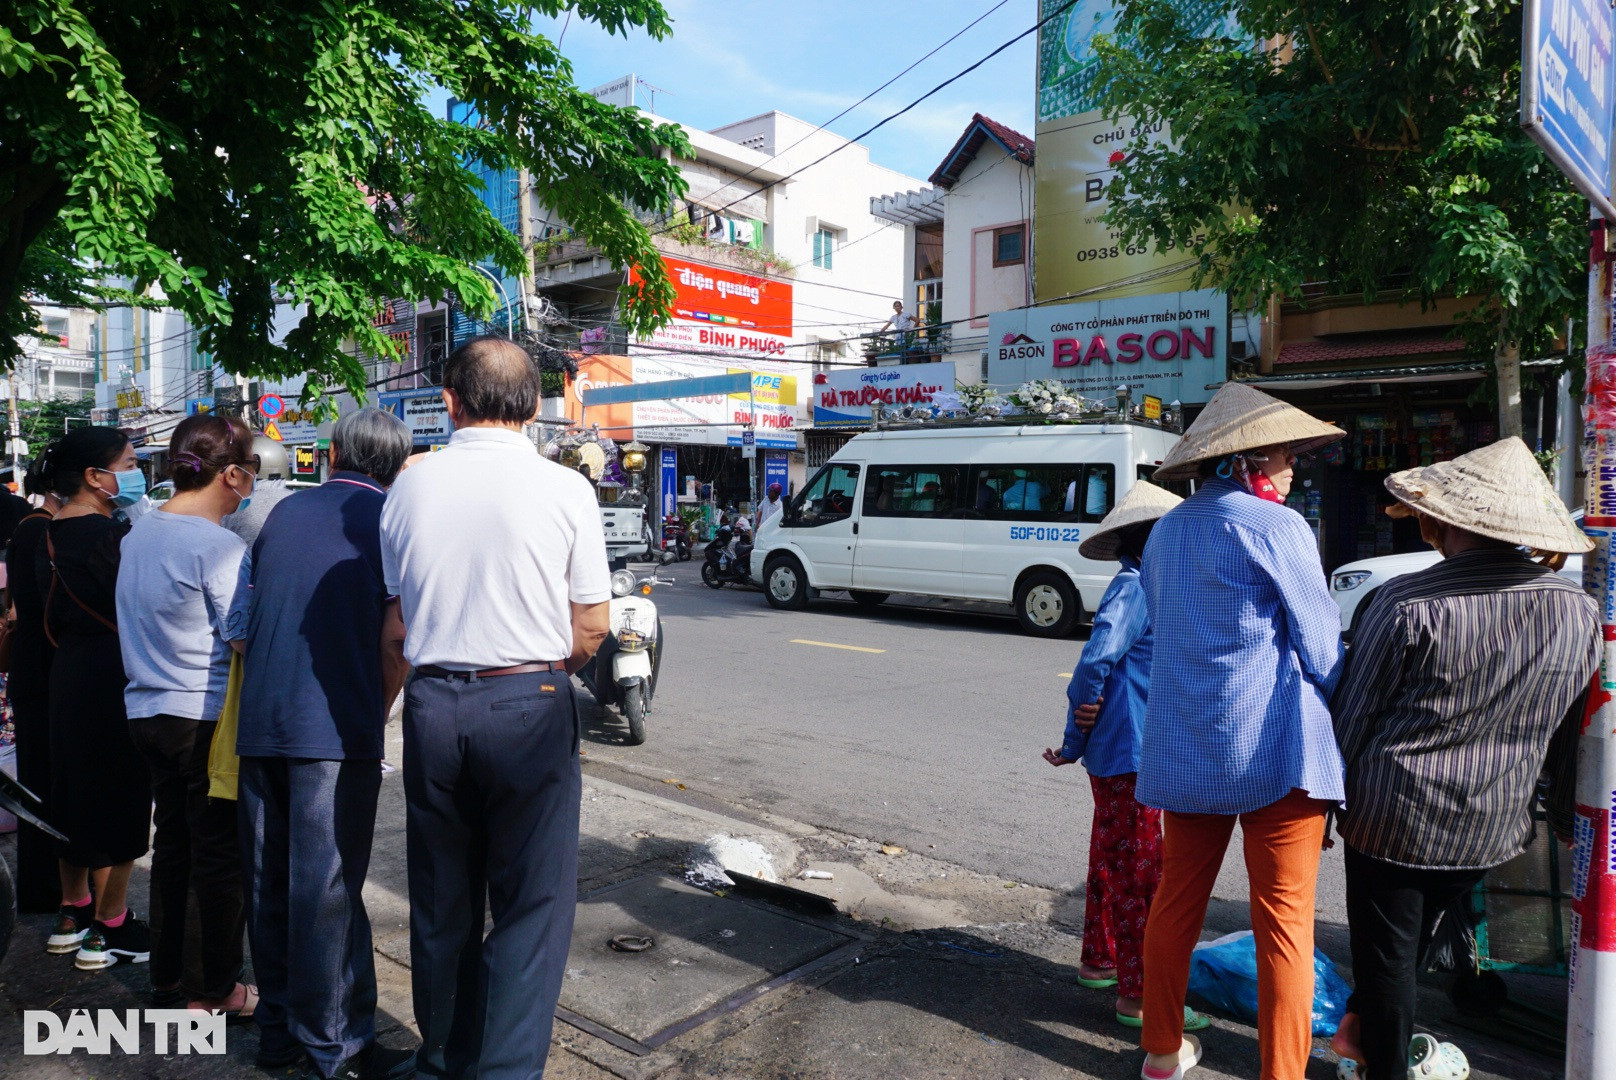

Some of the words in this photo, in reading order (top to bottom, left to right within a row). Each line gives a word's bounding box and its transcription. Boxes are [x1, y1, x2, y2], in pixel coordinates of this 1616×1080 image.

[1570, 5, 1590, 82] PHÚ
[1544, 49, 1562, 98] 50m
[1093, 127, 1124, 145] CHỦ
[1076, 246, 1120, 262] 0938
[674, 268, 714, 291] điện
[716, 280, 760, 305] quang
[1050, 322, 1073, 333] CÔNG
[1075, 322, 1085, 330] TY
[1087, 316, 1099, 329] CỔ
[1100, 314, 1124, 328] PHẦN
[1126, 315, 1149, 326] PHÁT
[1151, 309, 1177, 323] TRIỂN
[1178, 309, 1192, 320] ĐÔ
[1194, 309, 1210, 320] THỊ
[700, 326, 735, 348] BÌNH
[740, 336, 786, 356] PHƯỚC
[999, 344, 1045, 360] BASON
[1052, 326, 1215, 368] BASON
[861, 372, 873, 383] Công
[822, 387, 839, 407] HÀ
[840, 385, 893, 407] TRƯỜNG
[896, 382, 943, 404] KHÁN
[763, 410, 794, 428] PHƯỚC
[296, 449, 313, 466] Yoga
